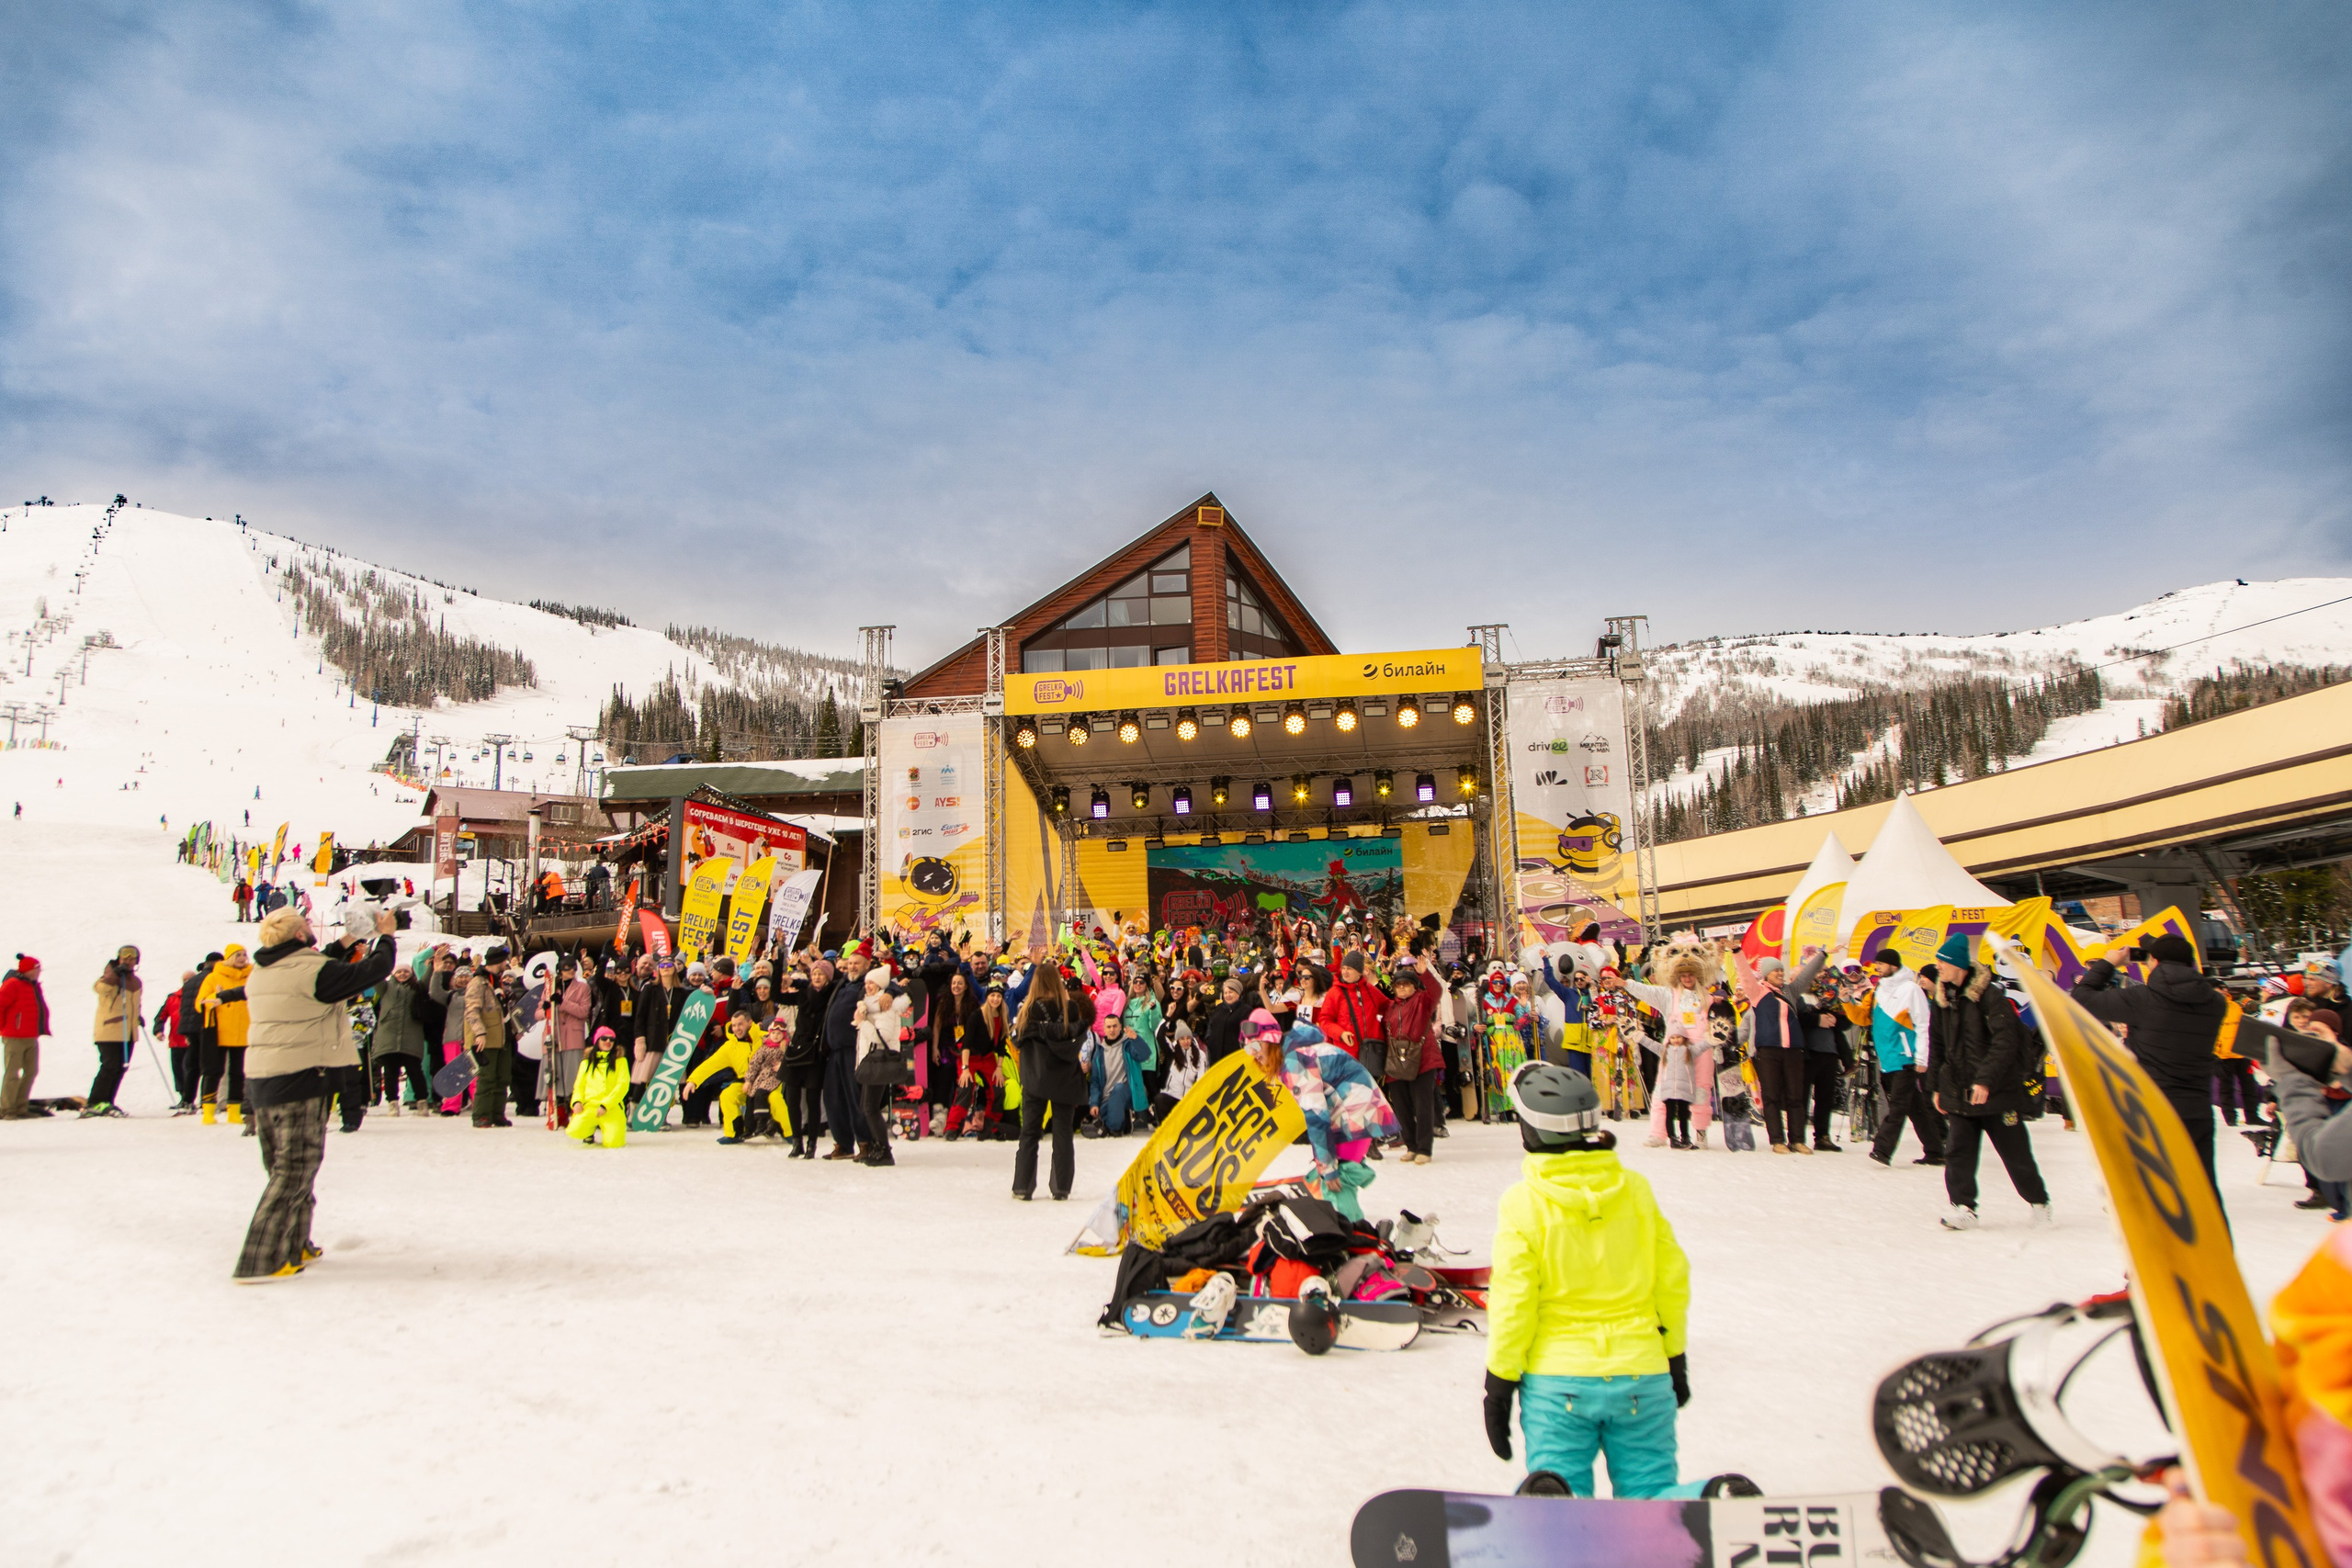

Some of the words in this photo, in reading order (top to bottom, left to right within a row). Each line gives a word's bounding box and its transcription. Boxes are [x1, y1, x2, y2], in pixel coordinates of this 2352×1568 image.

[1383, 661, 1445, 678] билайн
[1164, 665, 1296, 696] GRELKAFEST
[1038, 682, 1063, 692] GRELKA
[1038, 692, 1056, 700] FEST
[1528, 741, 1568, 751] drivee
[689, 807, 729, 824] СОГРЕВАЕМ
[735, 818, 766, 832] ШЕРЕГЕШЕ
[768, 827, 781, 836] УЖЕ
[788, 830, 802, 841] ЛЕТ!
[784, 852, 791, 862] Ср
[1355, 846, 1393, 856] билайн
[1170, 895, 1211, 909] GRELKA
[1170, 910, 1199, 925] FEST
[1962, 909, 1985, 920] FEST
[1205, 1064, 1280, 1163] NICE
[1163, 1104, 1241, 1217] BUS
[1168, 1192, 1176, 1202] В
